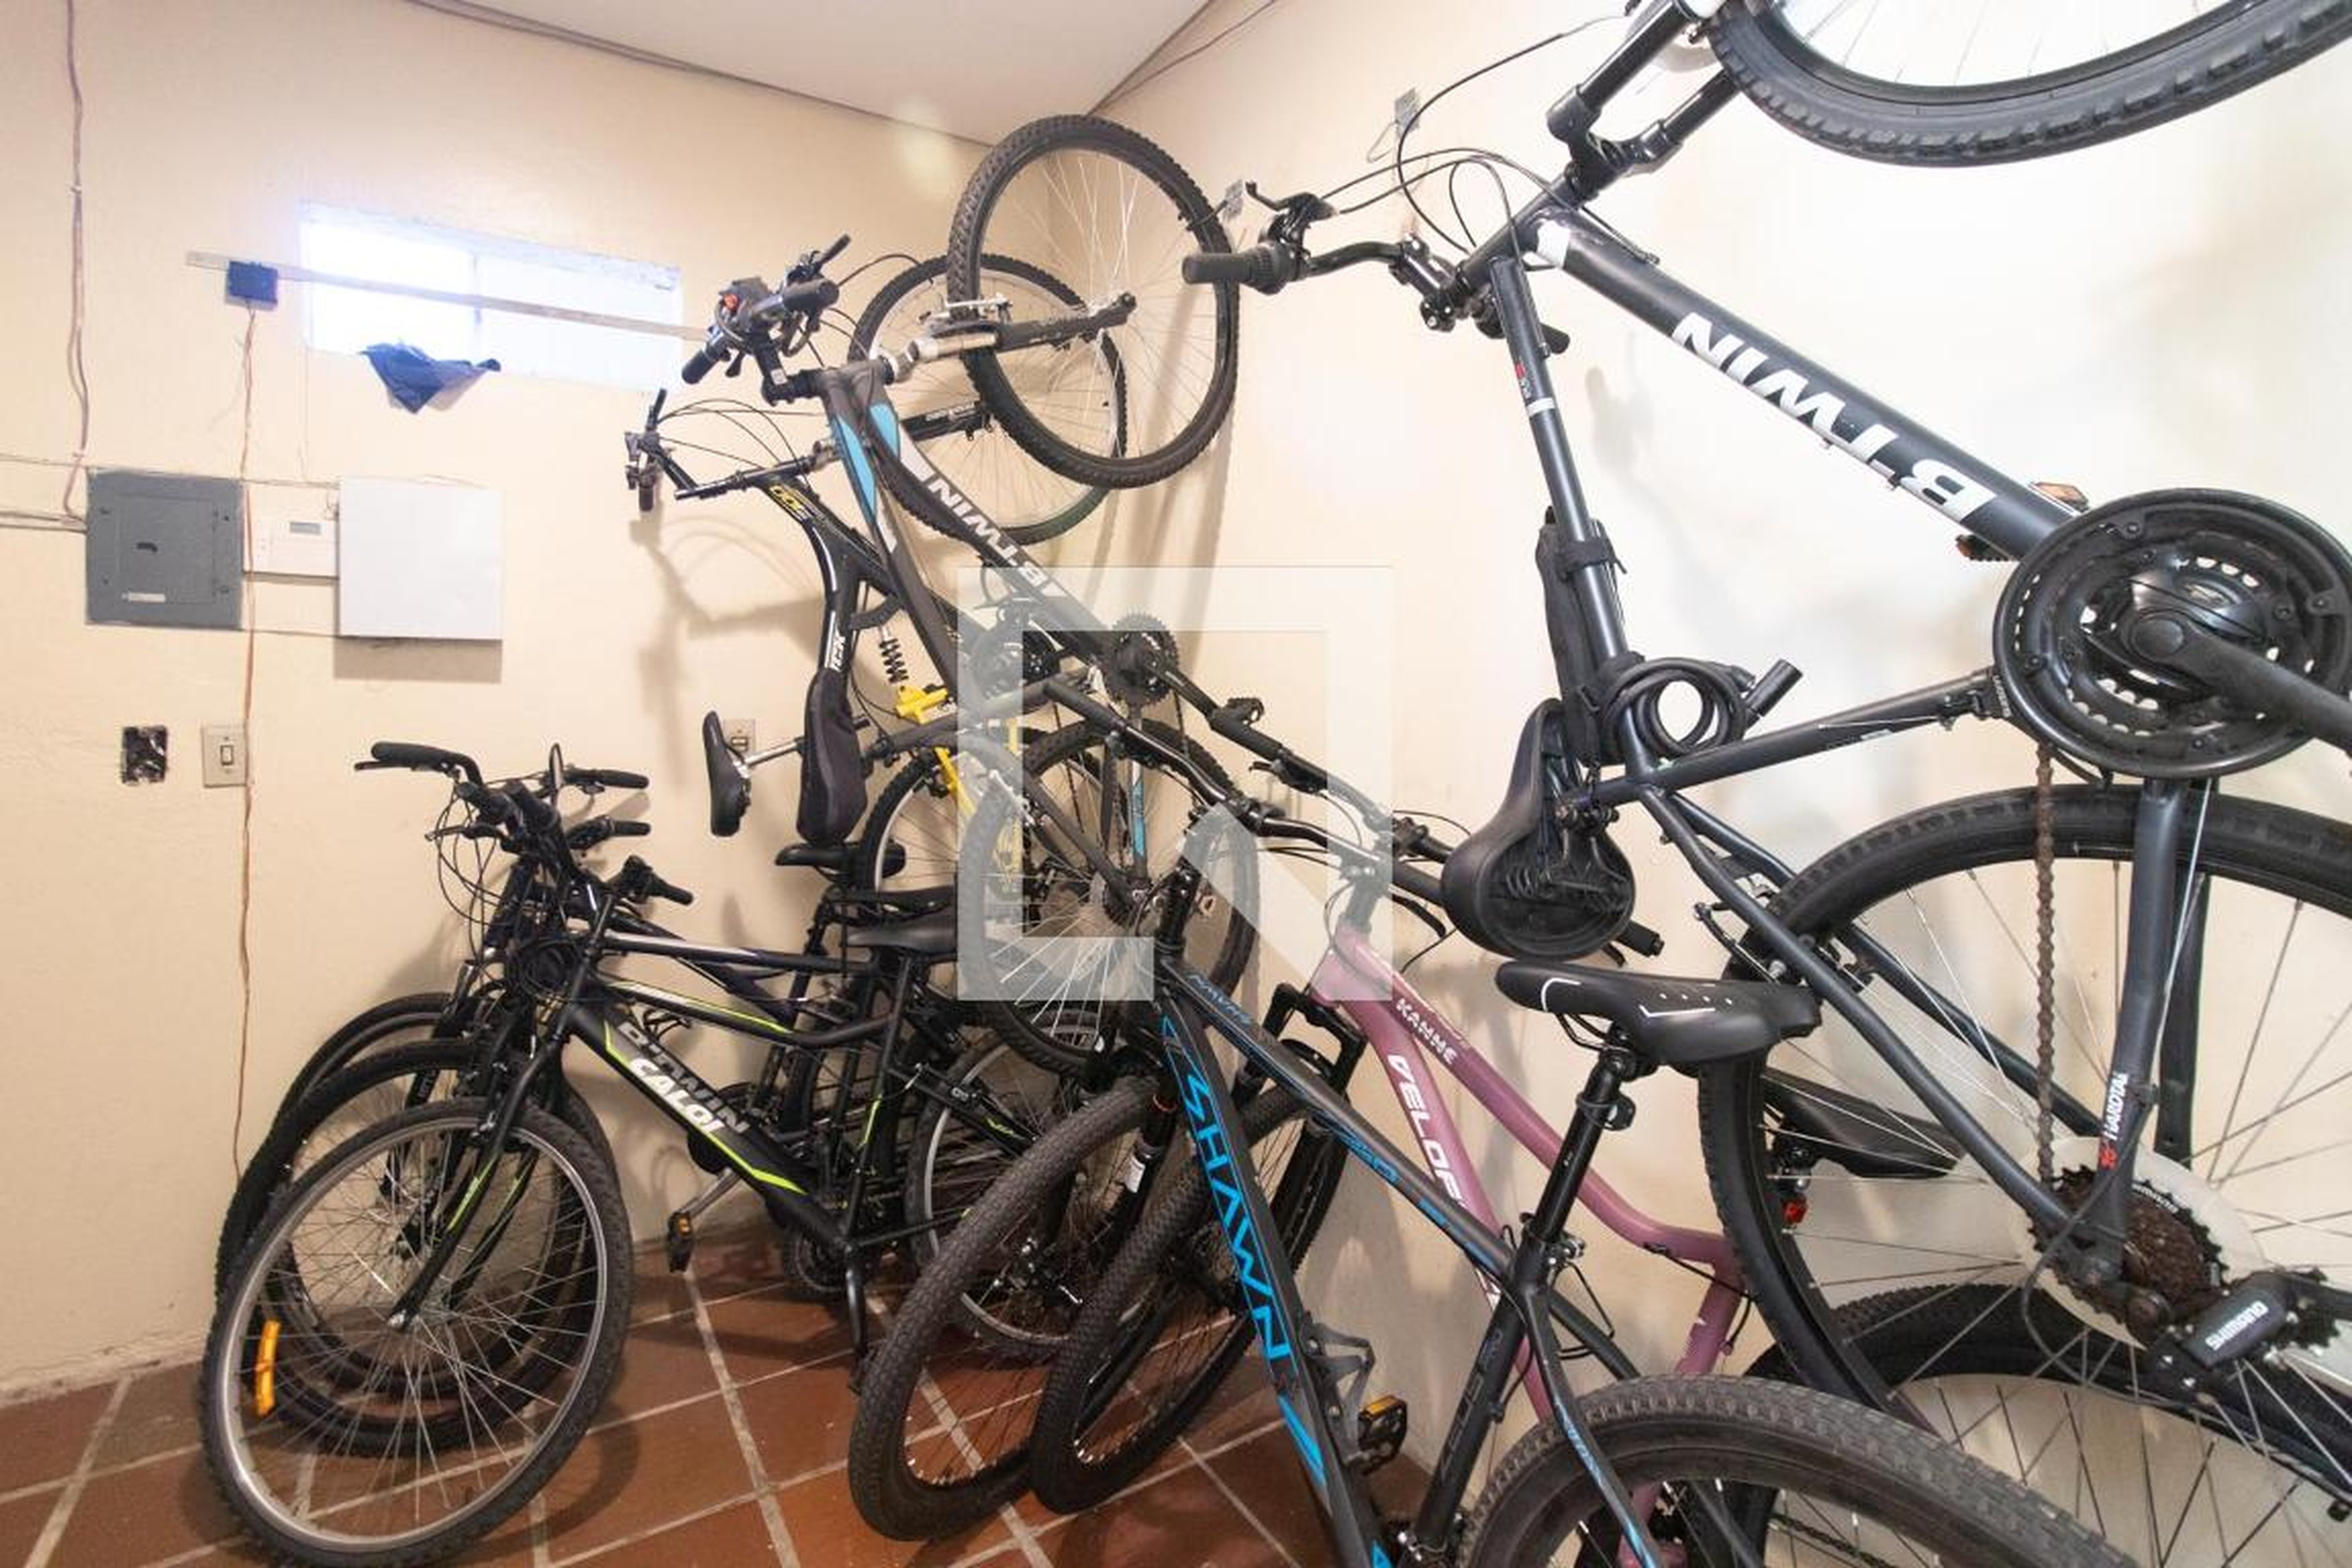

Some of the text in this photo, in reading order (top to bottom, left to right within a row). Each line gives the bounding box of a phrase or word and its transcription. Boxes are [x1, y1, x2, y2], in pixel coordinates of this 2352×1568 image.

[630, 1058, 725, 1132] CALOI
[1387, 1054, 1468, 1208] VELOF
[1185, 1072, 1292, 1360] SHAWN
[2204, 1300, 2269, 1351] SHIMANO
